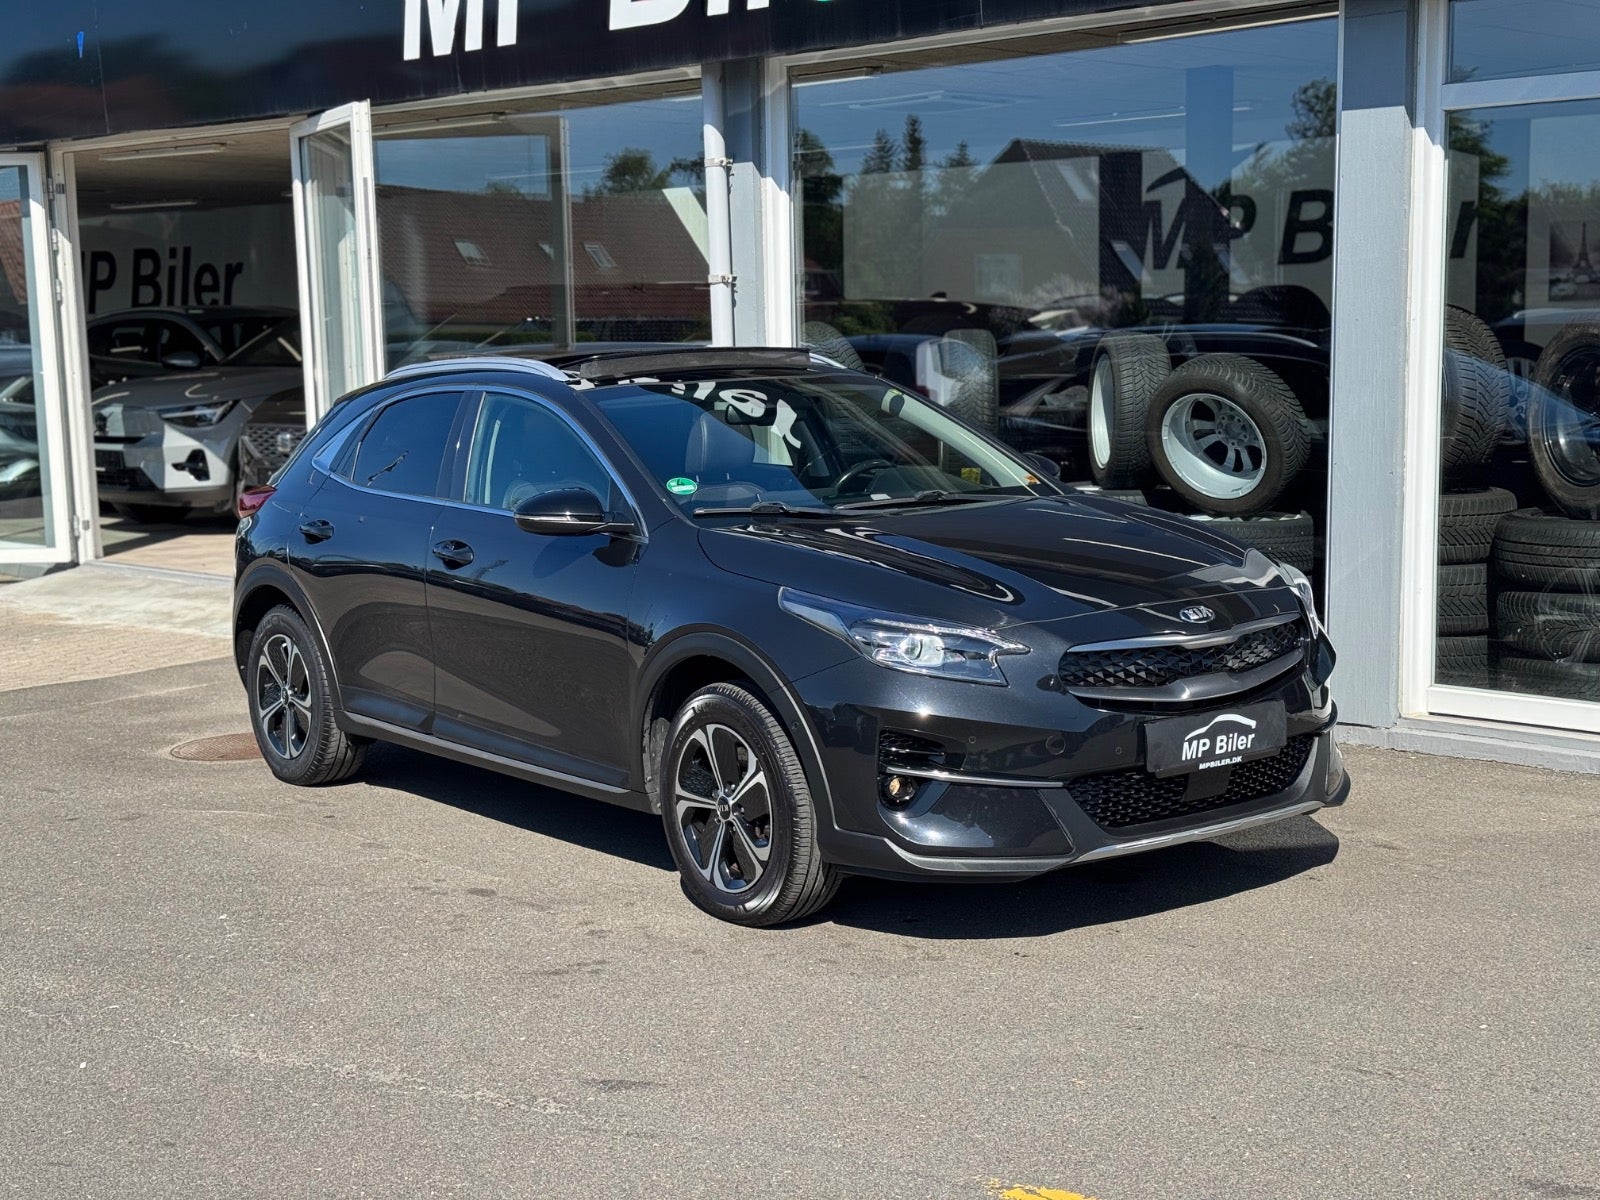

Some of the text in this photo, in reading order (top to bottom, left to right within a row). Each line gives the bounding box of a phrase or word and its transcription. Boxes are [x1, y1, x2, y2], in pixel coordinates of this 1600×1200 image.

[82, 246, 244, 314] P Biler
[1183, 605, 1212, 620] KIA
[1181, 732, 1256, 761] MP Biler
[1198, 755, 1243, 770] MPBILER.DK
